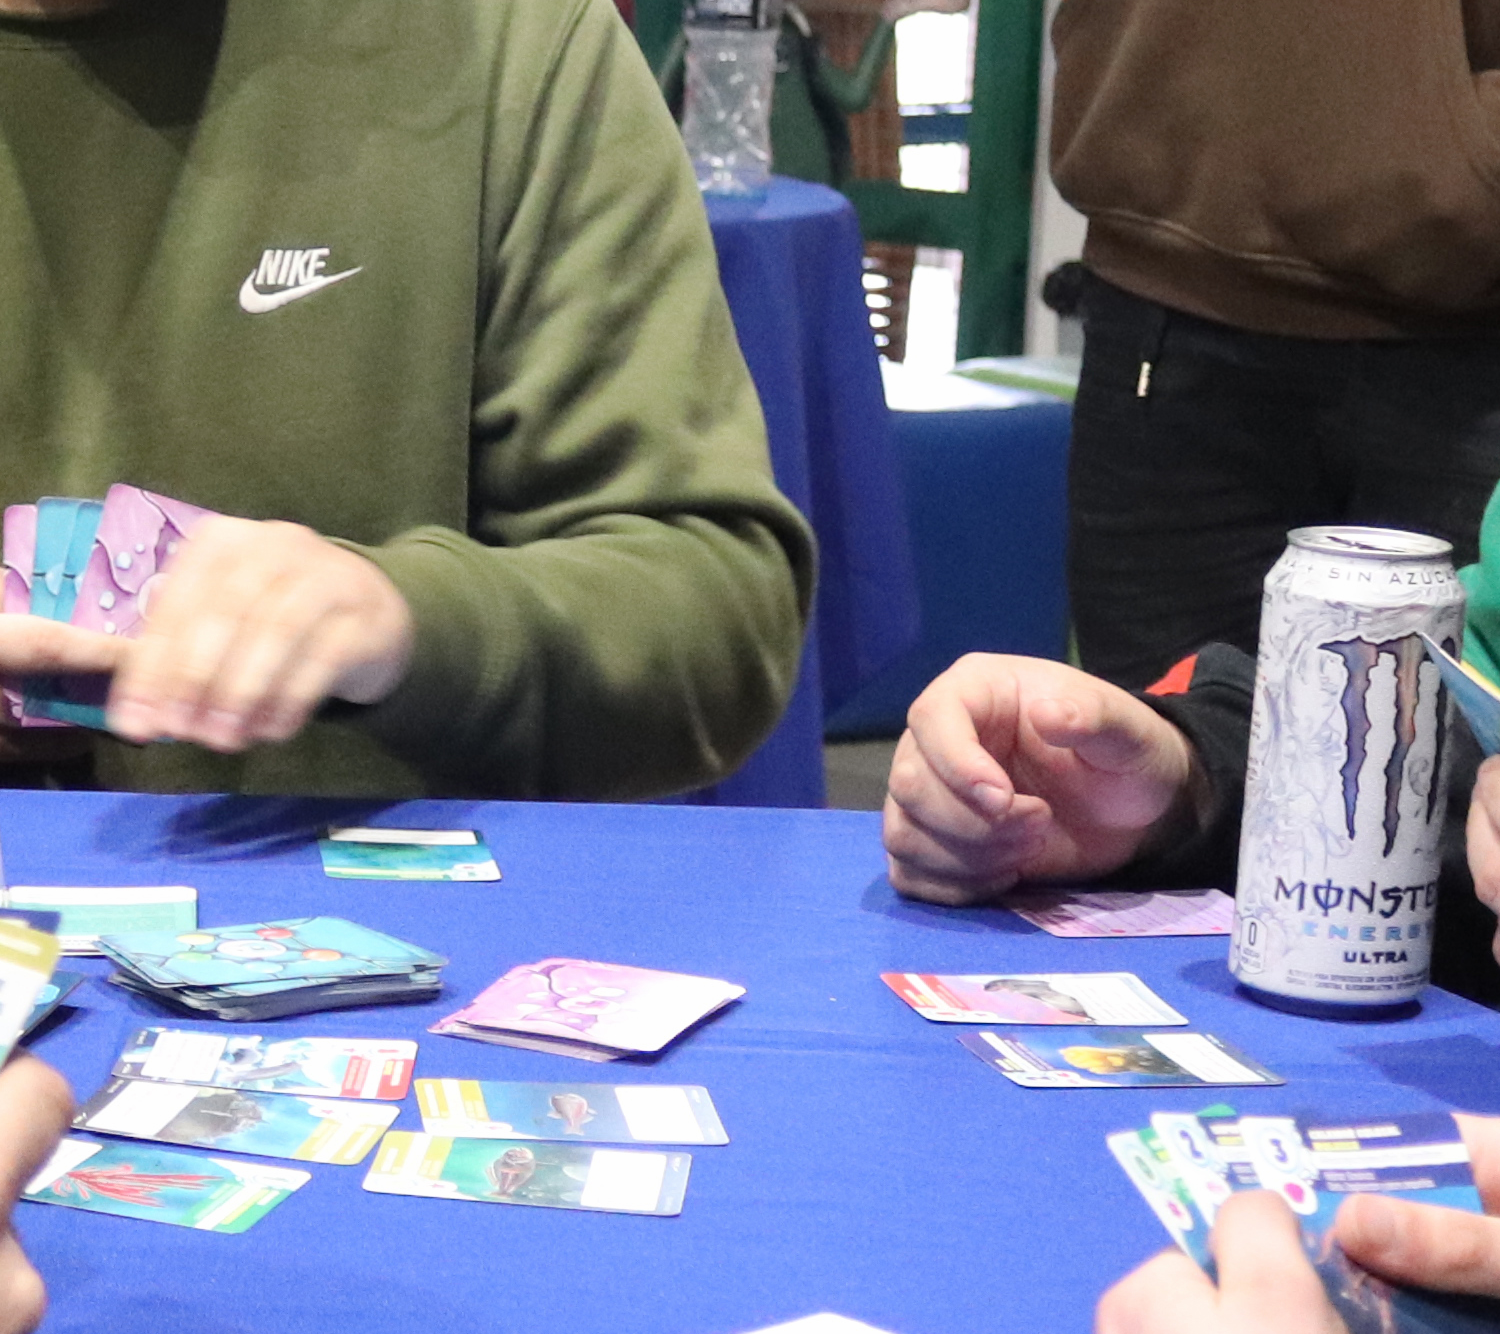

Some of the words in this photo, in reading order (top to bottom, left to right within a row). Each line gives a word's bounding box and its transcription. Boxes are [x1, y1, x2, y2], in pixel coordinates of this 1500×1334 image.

[254, 248, 331, 287] NIKE
[1328, 568, 1372, 584] SIN
[1275, 875, 1437, 919] MONSTE
[1248, 921, 1258, 947] 0
[1302, 919, 1433, 942] ENERG
[1343, 950, 1408, 965] ULTRA
